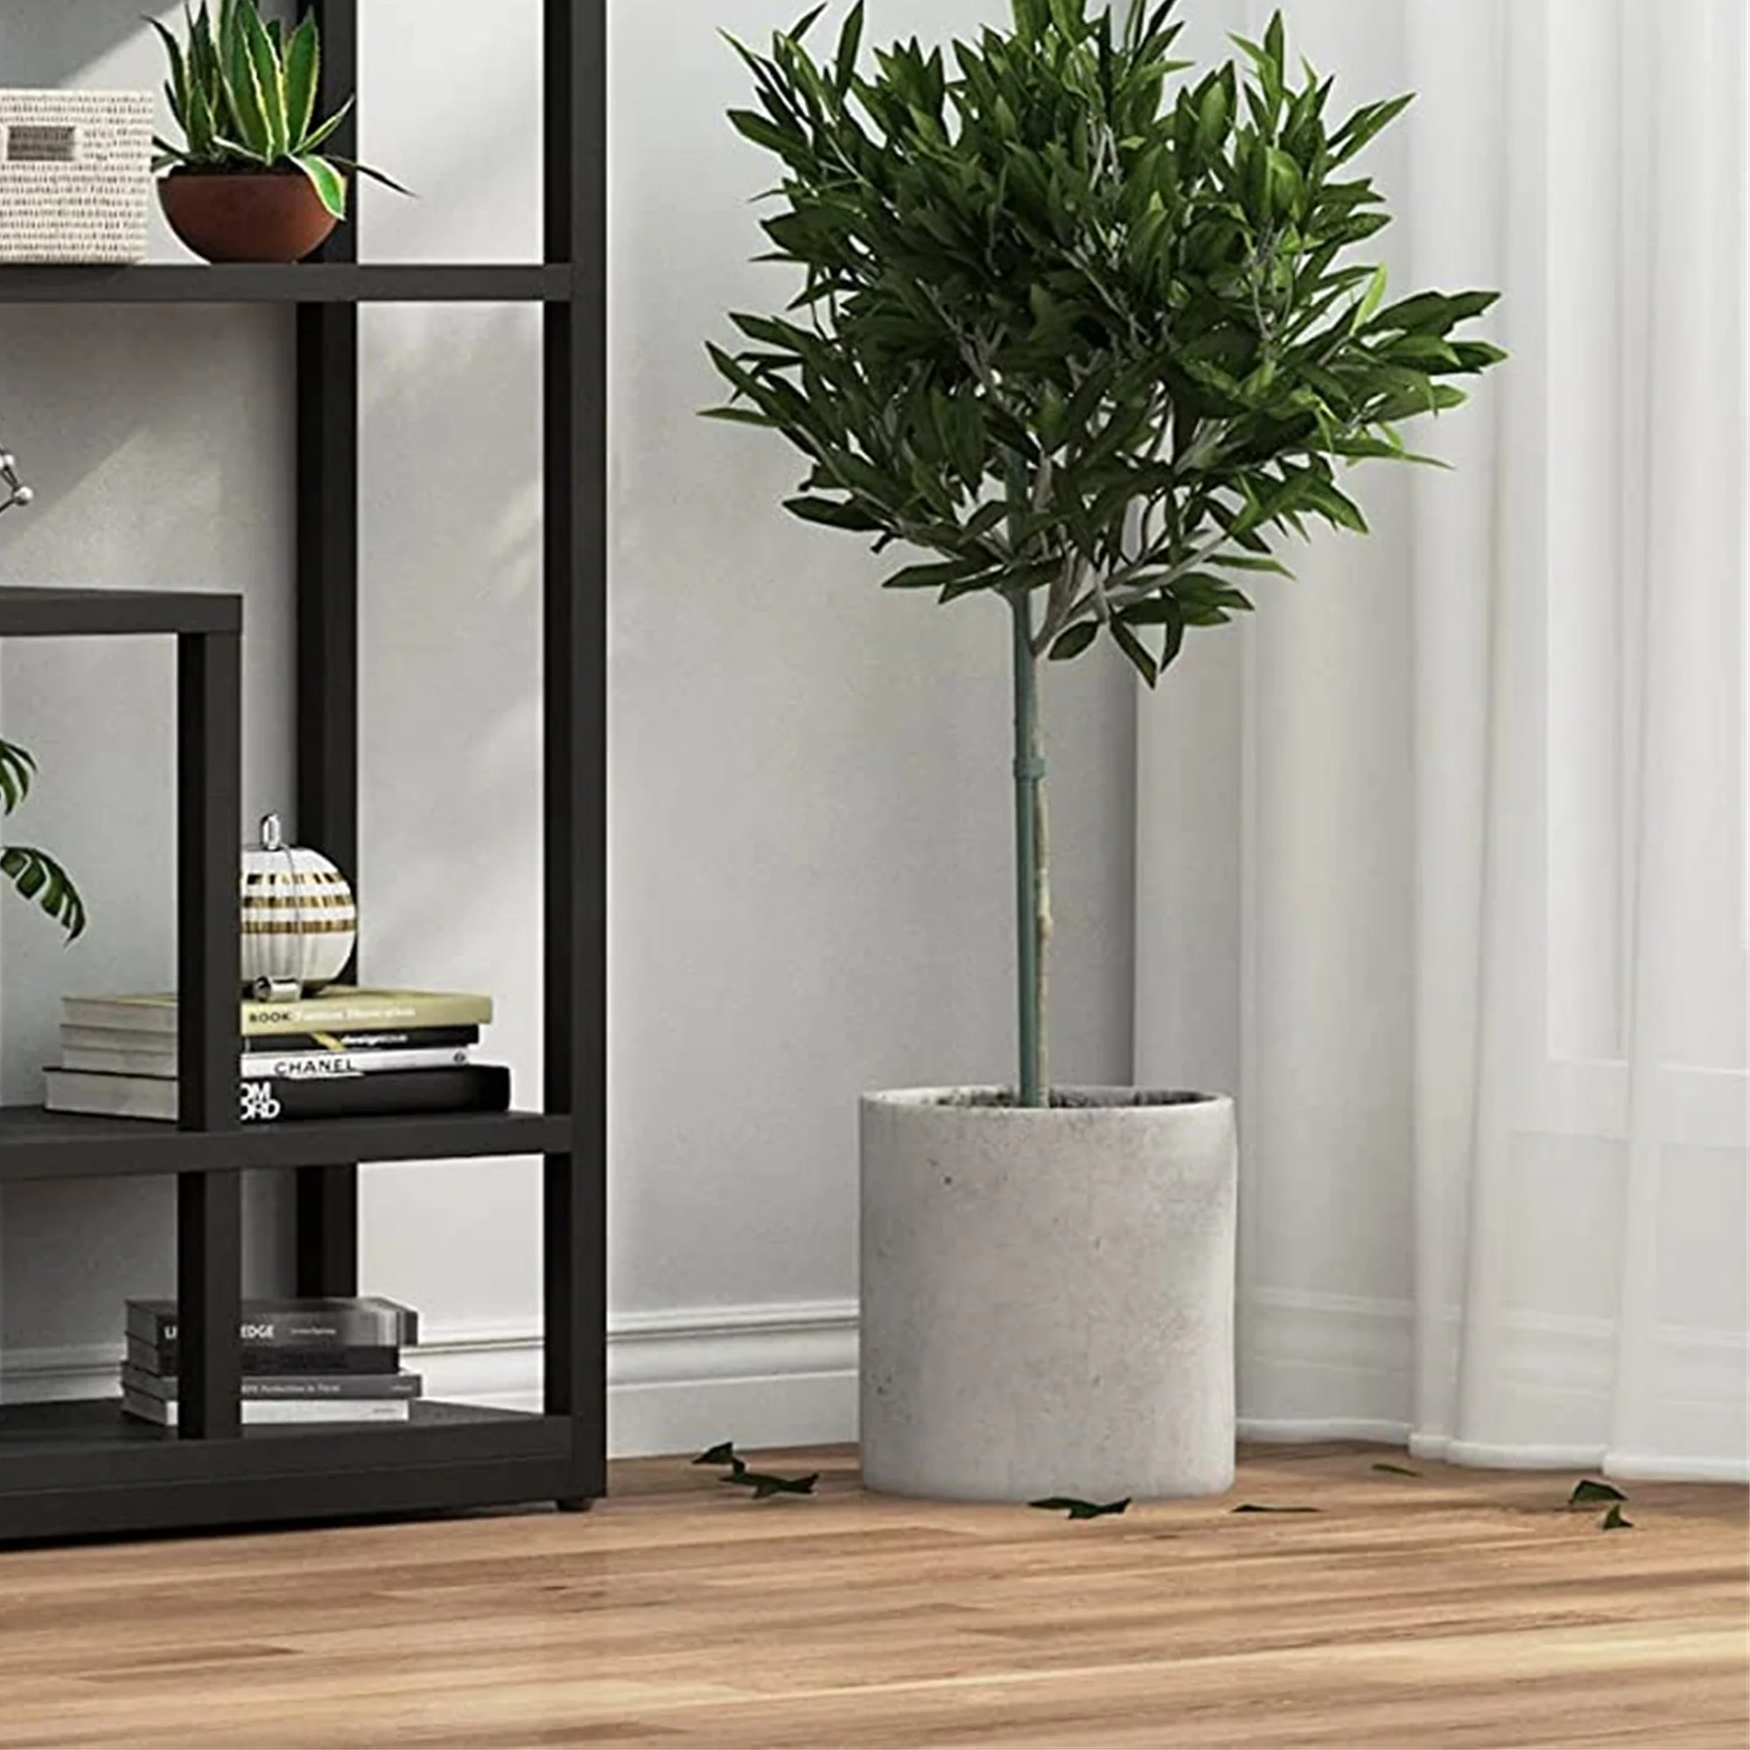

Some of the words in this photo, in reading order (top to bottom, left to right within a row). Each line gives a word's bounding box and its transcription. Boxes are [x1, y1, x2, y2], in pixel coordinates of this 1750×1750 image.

[248, 1012, 292, 1024] BOOK
[273, 1058, 357, 1076] CHANEL
[240, 1080, 273, 1102] OM
[240, 1098, 281, 1120] ORD
